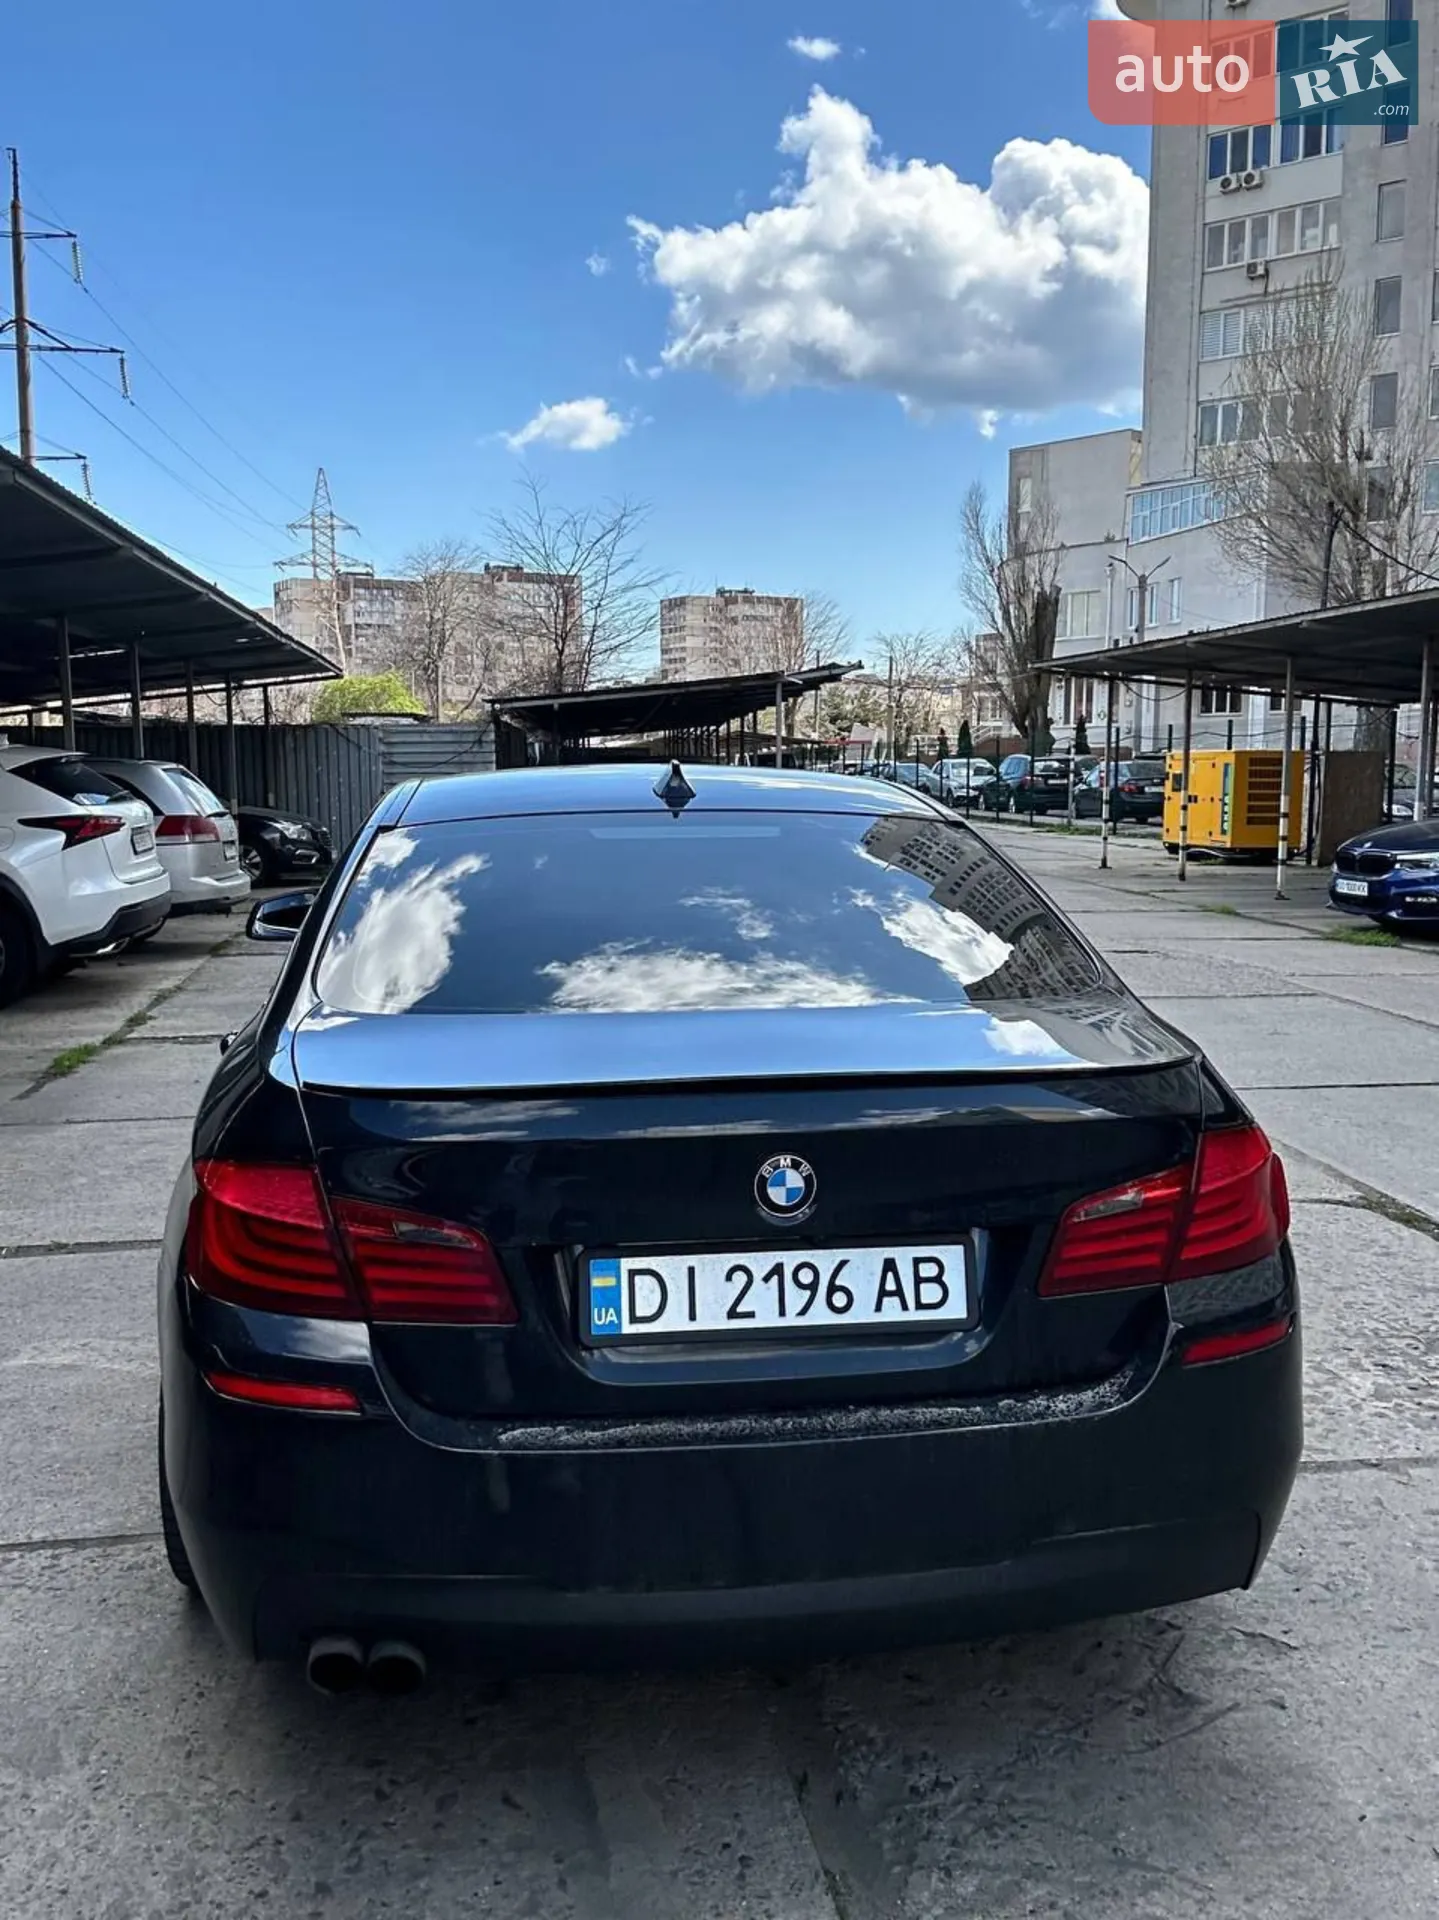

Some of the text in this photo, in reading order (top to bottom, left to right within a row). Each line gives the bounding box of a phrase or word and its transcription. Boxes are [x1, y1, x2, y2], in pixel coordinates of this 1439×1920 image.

[761, 1157, 812, 1178] BMW
[627, 1255, 950, 1325] DI 2196 AB
[593, 1307, 619, 1326] UA
